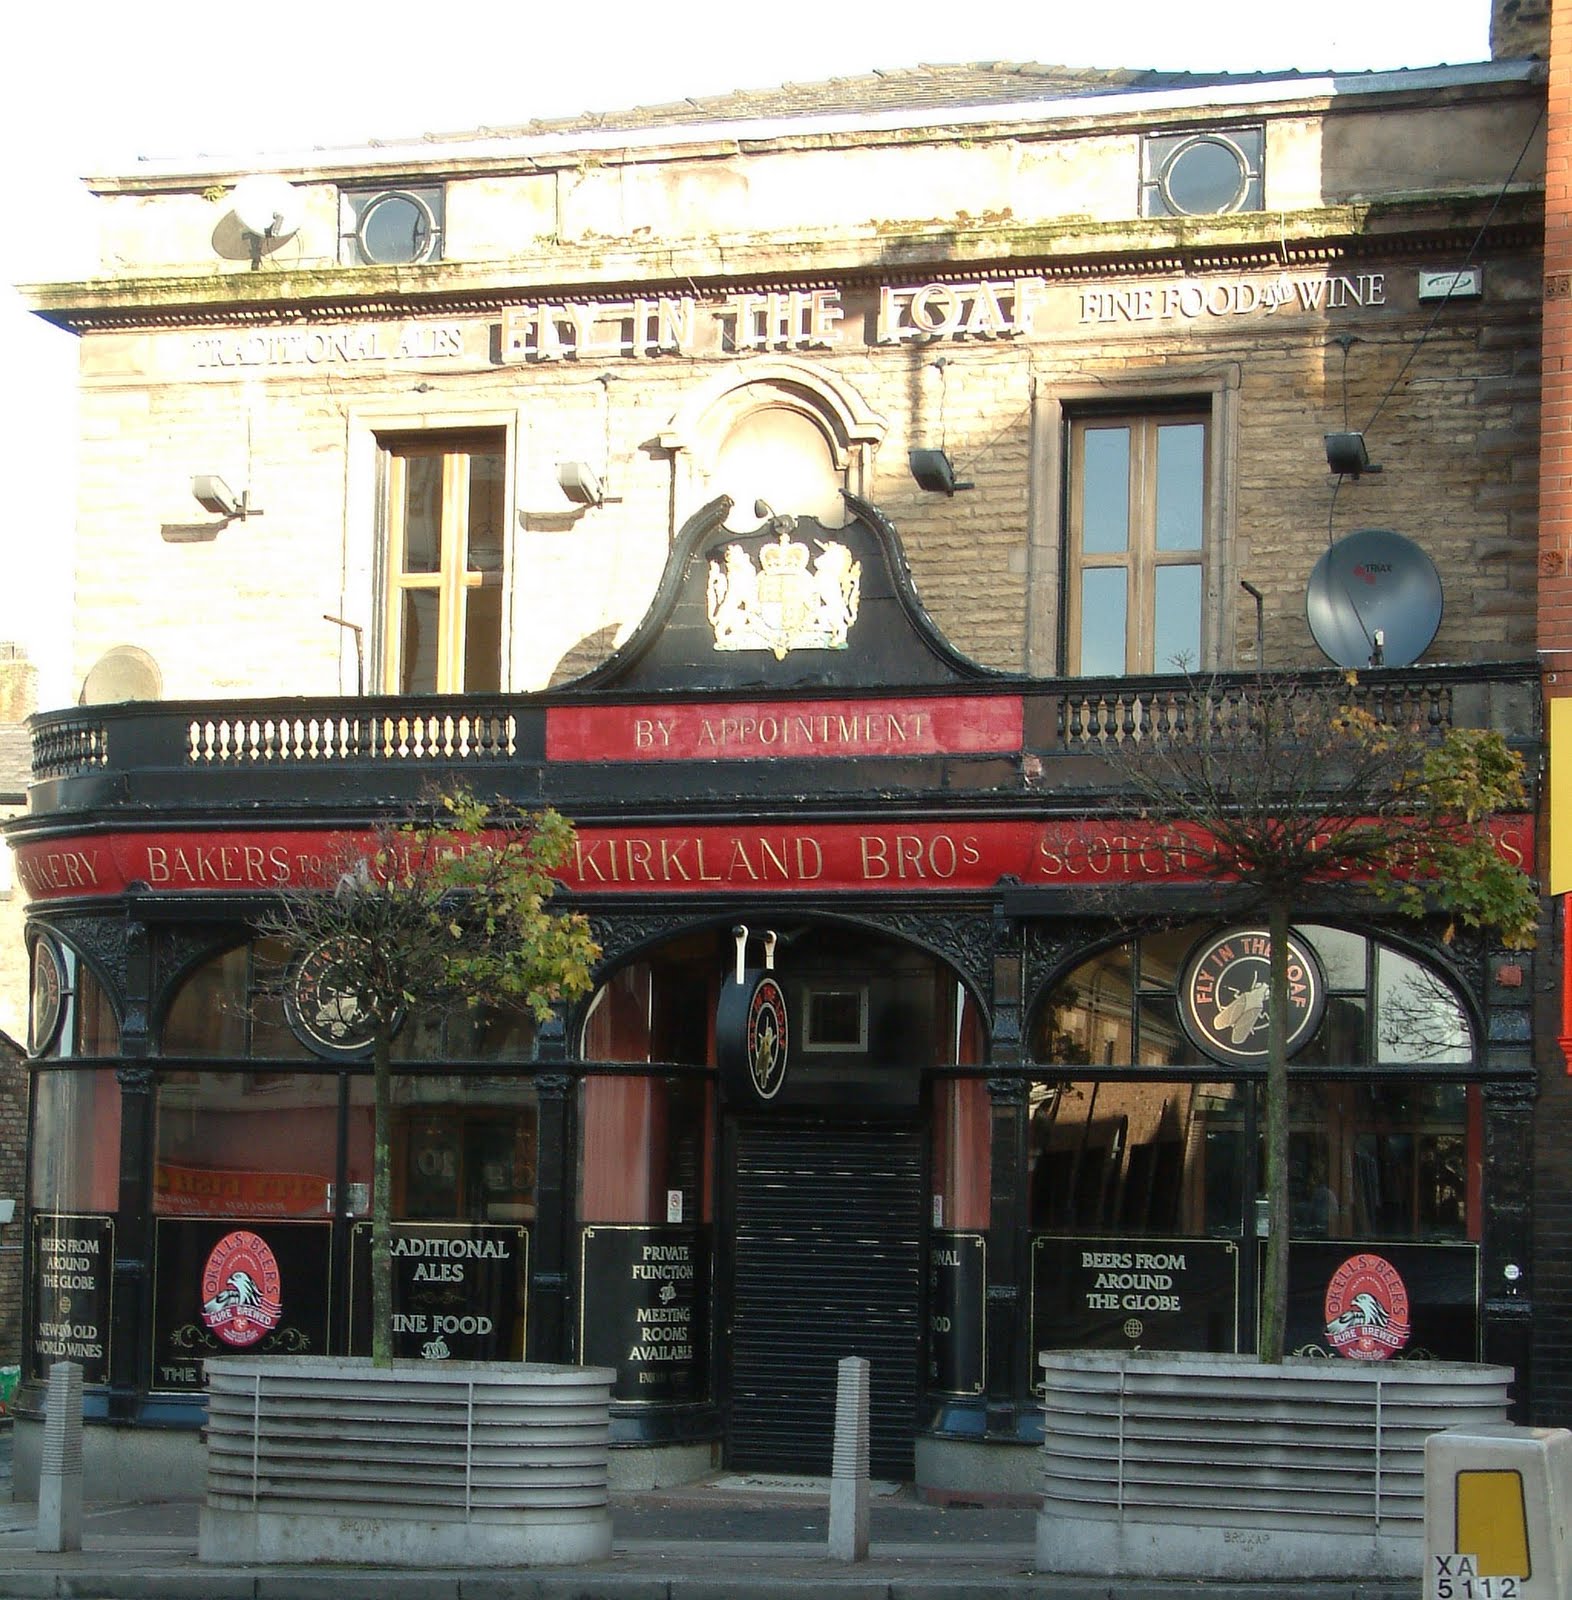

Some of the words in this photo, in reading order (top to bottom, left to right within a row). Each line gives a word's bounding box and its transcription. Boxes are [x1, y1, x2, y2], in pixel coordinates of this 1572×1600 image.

[1079, 286, 1153, 324] FINE
[1161, 280, 1260, 320] FOOD
[1296, 274, 1386, 312] WINE
[500, 300, 599, 363] FLY
[633, 295, 696, 357] IN
[727, 287, 844, 349] THE
[876, 276, 1046, 345] LOAF
[635, 719, 675, 748] BY
[698, 713, 929, 746] APPOINTMENT
[147, 846, 290, 882] BAKERS
[575, 836, 823, 882] KIRKLAND
[1041, 836, 1188, 874] SCOTCH
[1196, 968, 1215, 1005] FLY
[1210, 943, 1235, 967] IN
[1287, 956, 1308, 1009] OAF
[41, 1238, 66, 1252] BEERS
[67, 1239, 99, 1254] FROM
[378, 1238, 510, 1259] RADITIONAL
[642, 1246, 689, 1261] PRIVATE
[47, 1256, 90, 1272] AROUND
[205, 1232, 245, 1294] OKELLS
[250, 1236, 278, 1295] BEERS
[1081, 1252, 1132, 1269] BEERS
[1135, 1253, 1187, 1270] FROM
[412, 1263, 465, 1282] ALES
[632, 1265, 694, 1280] FUNCTION
[1094, 1273, 1173, 1290] AROUND
[43, 1275, 59, 1288] THE
[60, 1275, 95, 1290] GLOBE
[1328, 1255, 1368, 1315] OKELLS
[1375, 1259, 1406, 1316] BEERS
[1086, 1293, 1120, 1309] THE
[1122, 1294, 1181, 1311] GLOBE
[210, 1308, 232, 1324] PURE
[237, 1307, 272, 1325] BREWED
[637, 1308, 691, 1322] MEETING
[40, 1322, 58, 1337] NEW
[73, 1325, 98, 1340] OLD
[391, 1314, 428, 1333] INE
[433, 1315, 493, 1335] FOOD
[642, 1327, 688, 1342] ROOMS
[1333, 1329, 1357, 1344] PURE
[1361, 1327, 1399, 1345] BREWED
[35, 1340, 66, 1355] WORLD
[67, 1342, 103, 1358] WINES
[628, 1346, 693, 1361] AVAILABLE
[160, 1366, 197, 1382] THE
[1437, 1577, 1517, 1599] 5112
